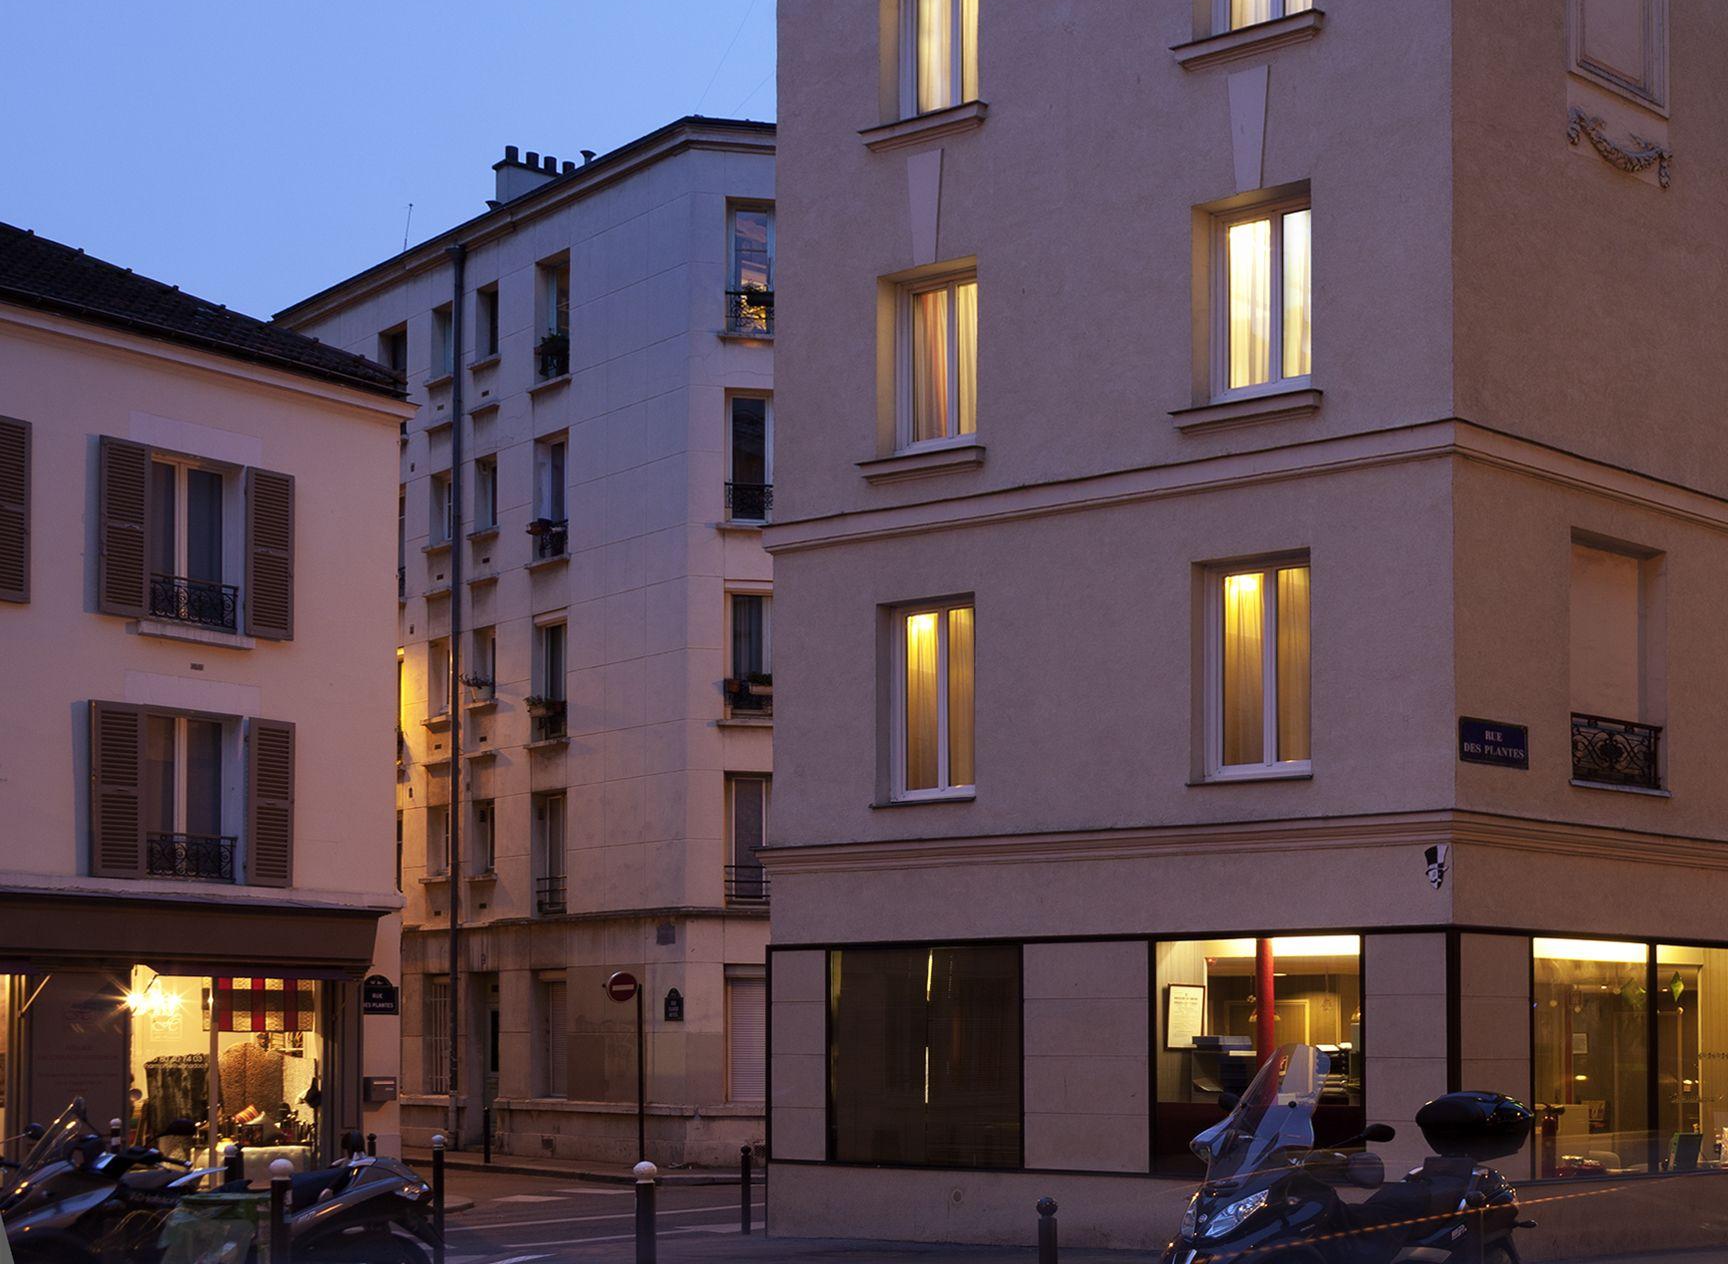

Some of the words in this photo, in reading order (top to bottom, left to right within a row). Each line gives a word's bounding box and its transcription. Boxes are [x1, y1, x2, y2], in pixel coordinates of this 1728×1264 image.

[1485, 730, 1503, 742] RUE
[1464, 742, 1481, 753] DES
[1485, 745, 1524, 758] PLANTES
